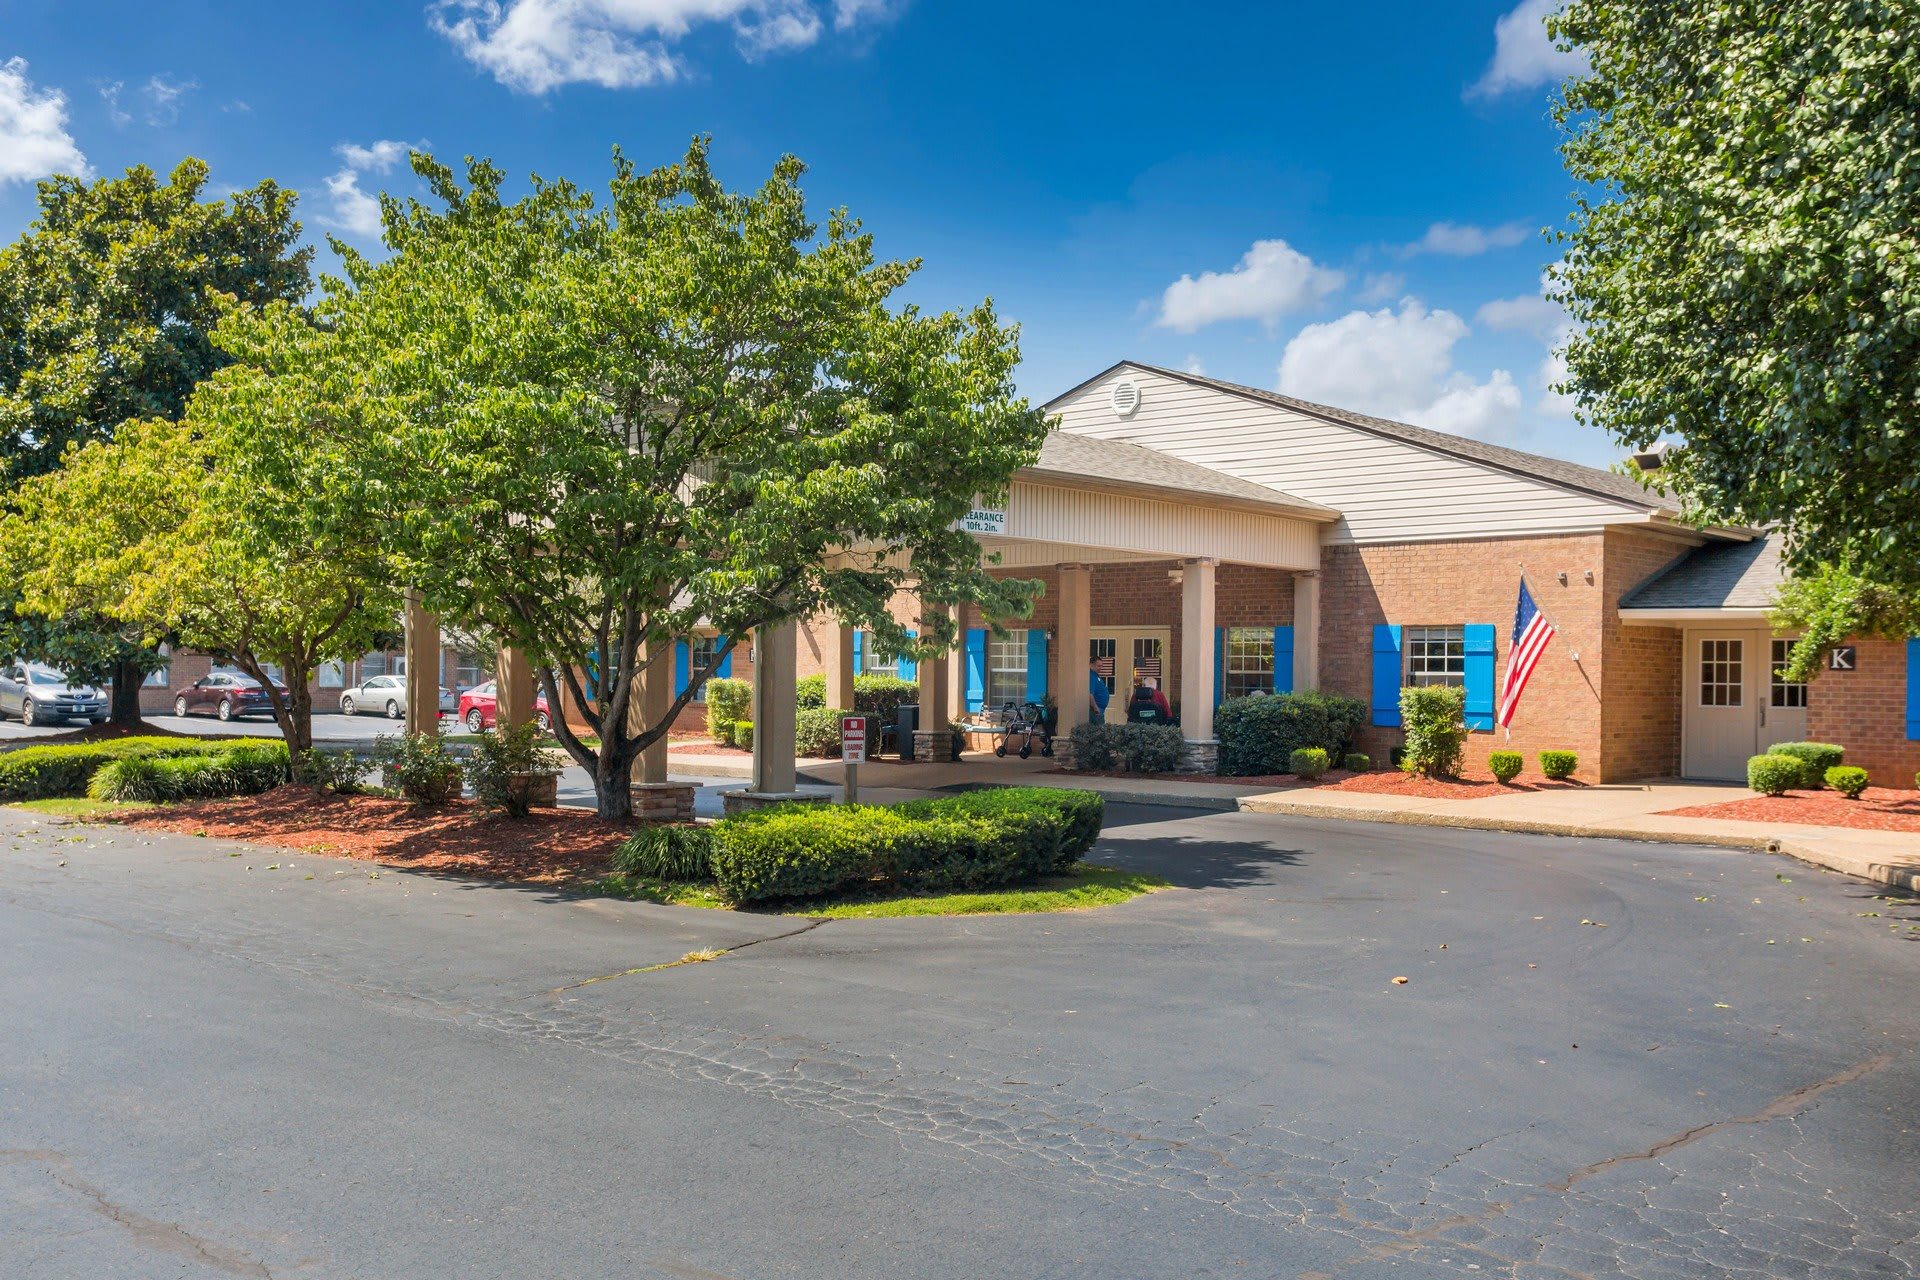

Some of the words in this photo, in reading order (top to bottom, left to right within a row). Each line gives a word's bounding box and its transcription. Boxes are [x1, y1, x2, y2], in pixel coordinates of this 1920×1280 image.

[963, 512, 1004, 522] LEARANCE
[966, 521, 983, 530] 10ft.
[984, 522, 998, 532] 2in.
[1830, 648, 1853, 669] K
